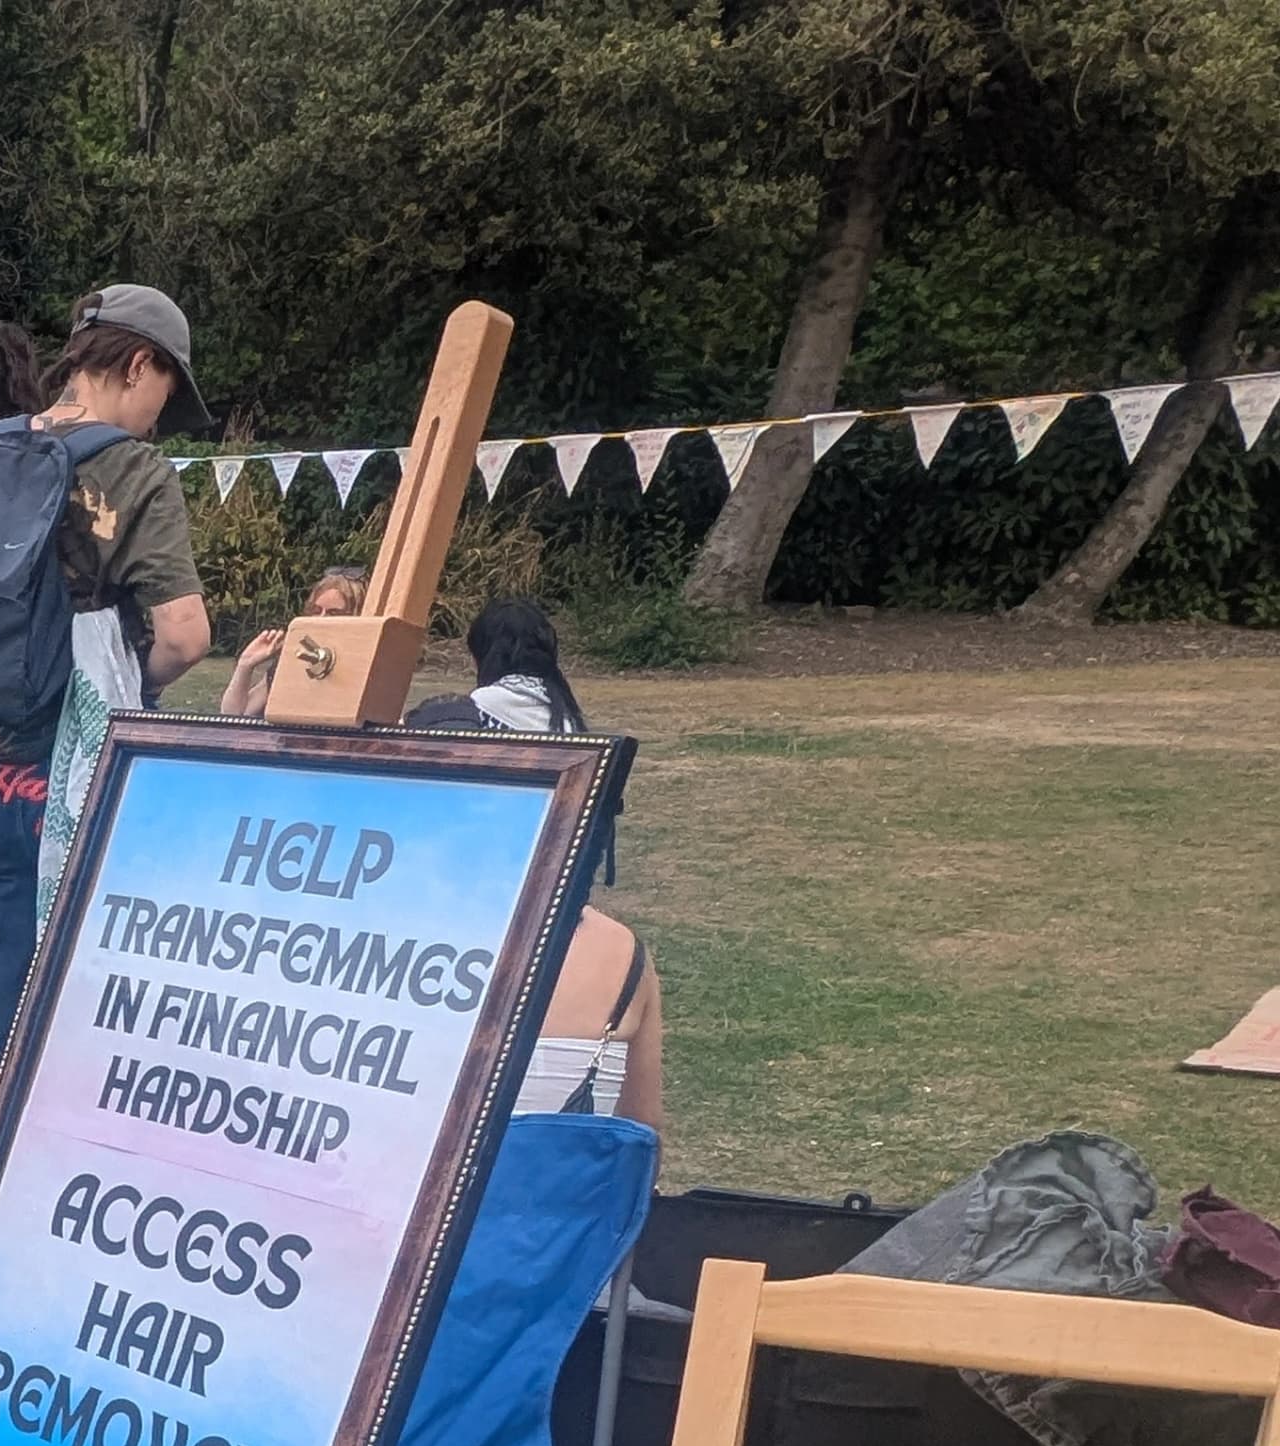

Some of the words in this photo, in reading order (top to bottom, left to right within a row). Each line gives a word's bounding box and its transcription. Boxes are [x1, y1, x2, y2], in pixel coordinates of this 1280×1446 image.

[220, 816, 393, 900] HELP
[101, 893, 493, 1013] TRANSFEMMES
[93, 974, 146, 1035] IN
[141, 985, 420, 1095] FINANCIAL
[97, 1057, 350, 1163] HARDSHIP
[51, 1172, 313, 1311] ACCESS
[76, 1281, 225, 1398] HAIR
